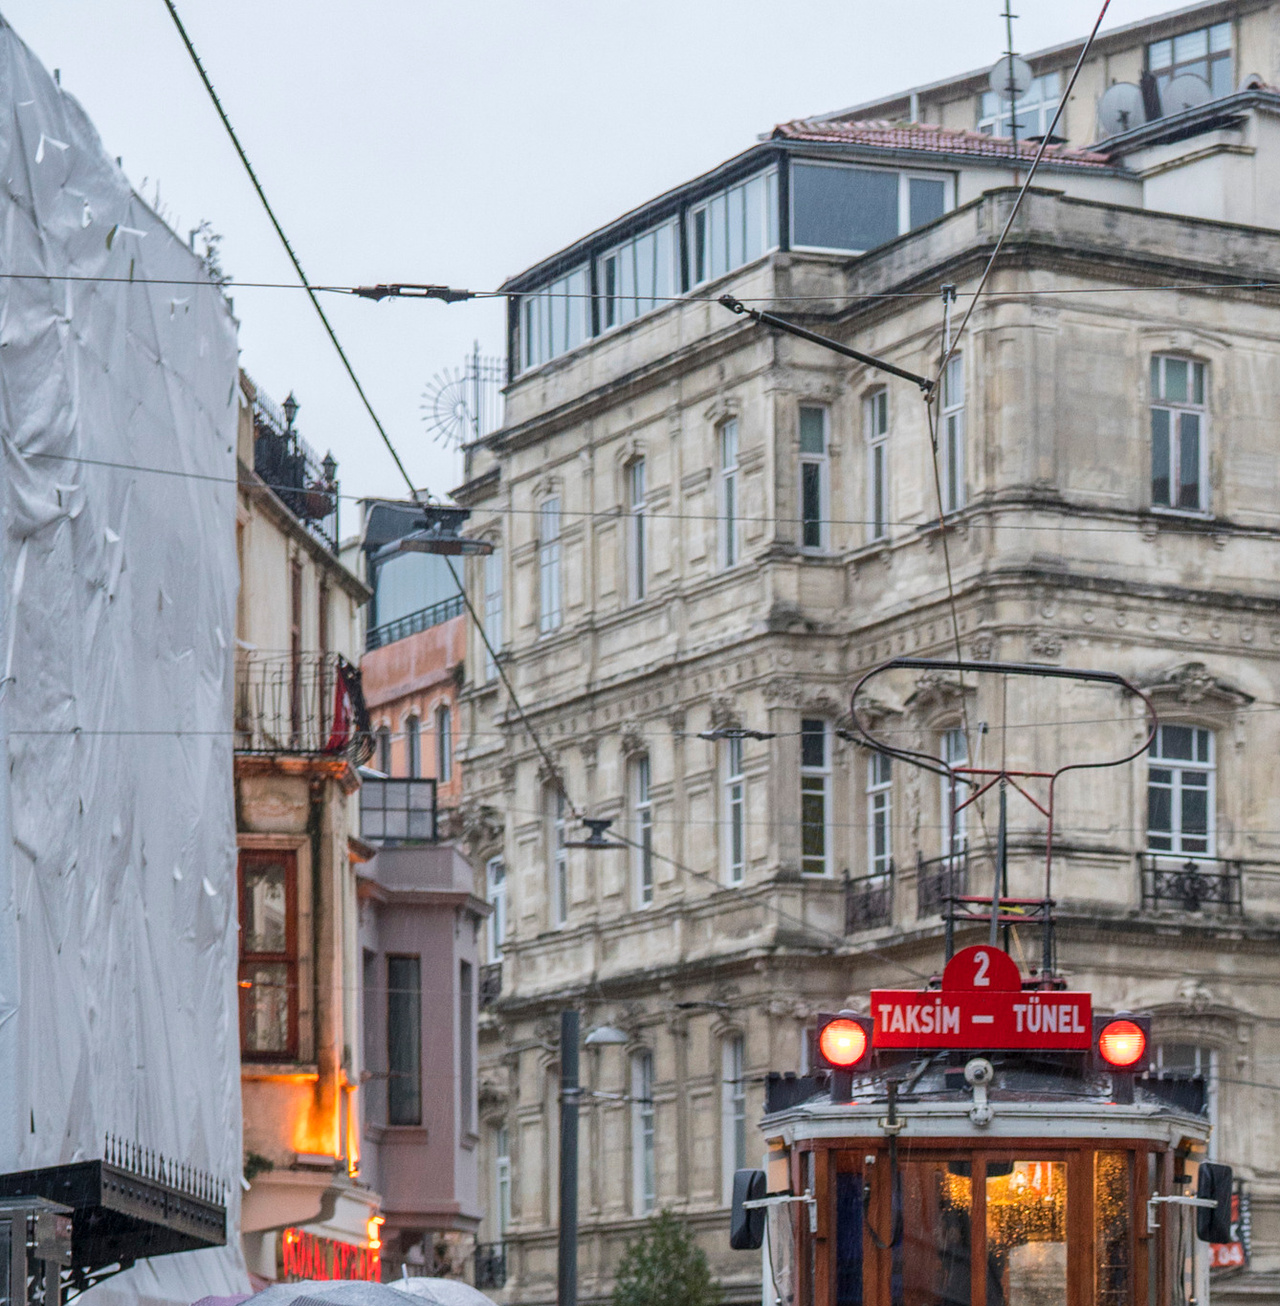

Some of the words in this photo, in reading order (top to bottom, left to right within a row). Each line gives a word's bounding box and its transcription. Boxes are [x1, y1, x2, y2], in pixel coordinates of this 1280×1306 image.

[973, 951, 990, 987] 2
[878, 998, 960, 1034] TAKSİM
[1013, 996, 1086, 1033] TÜNEL
